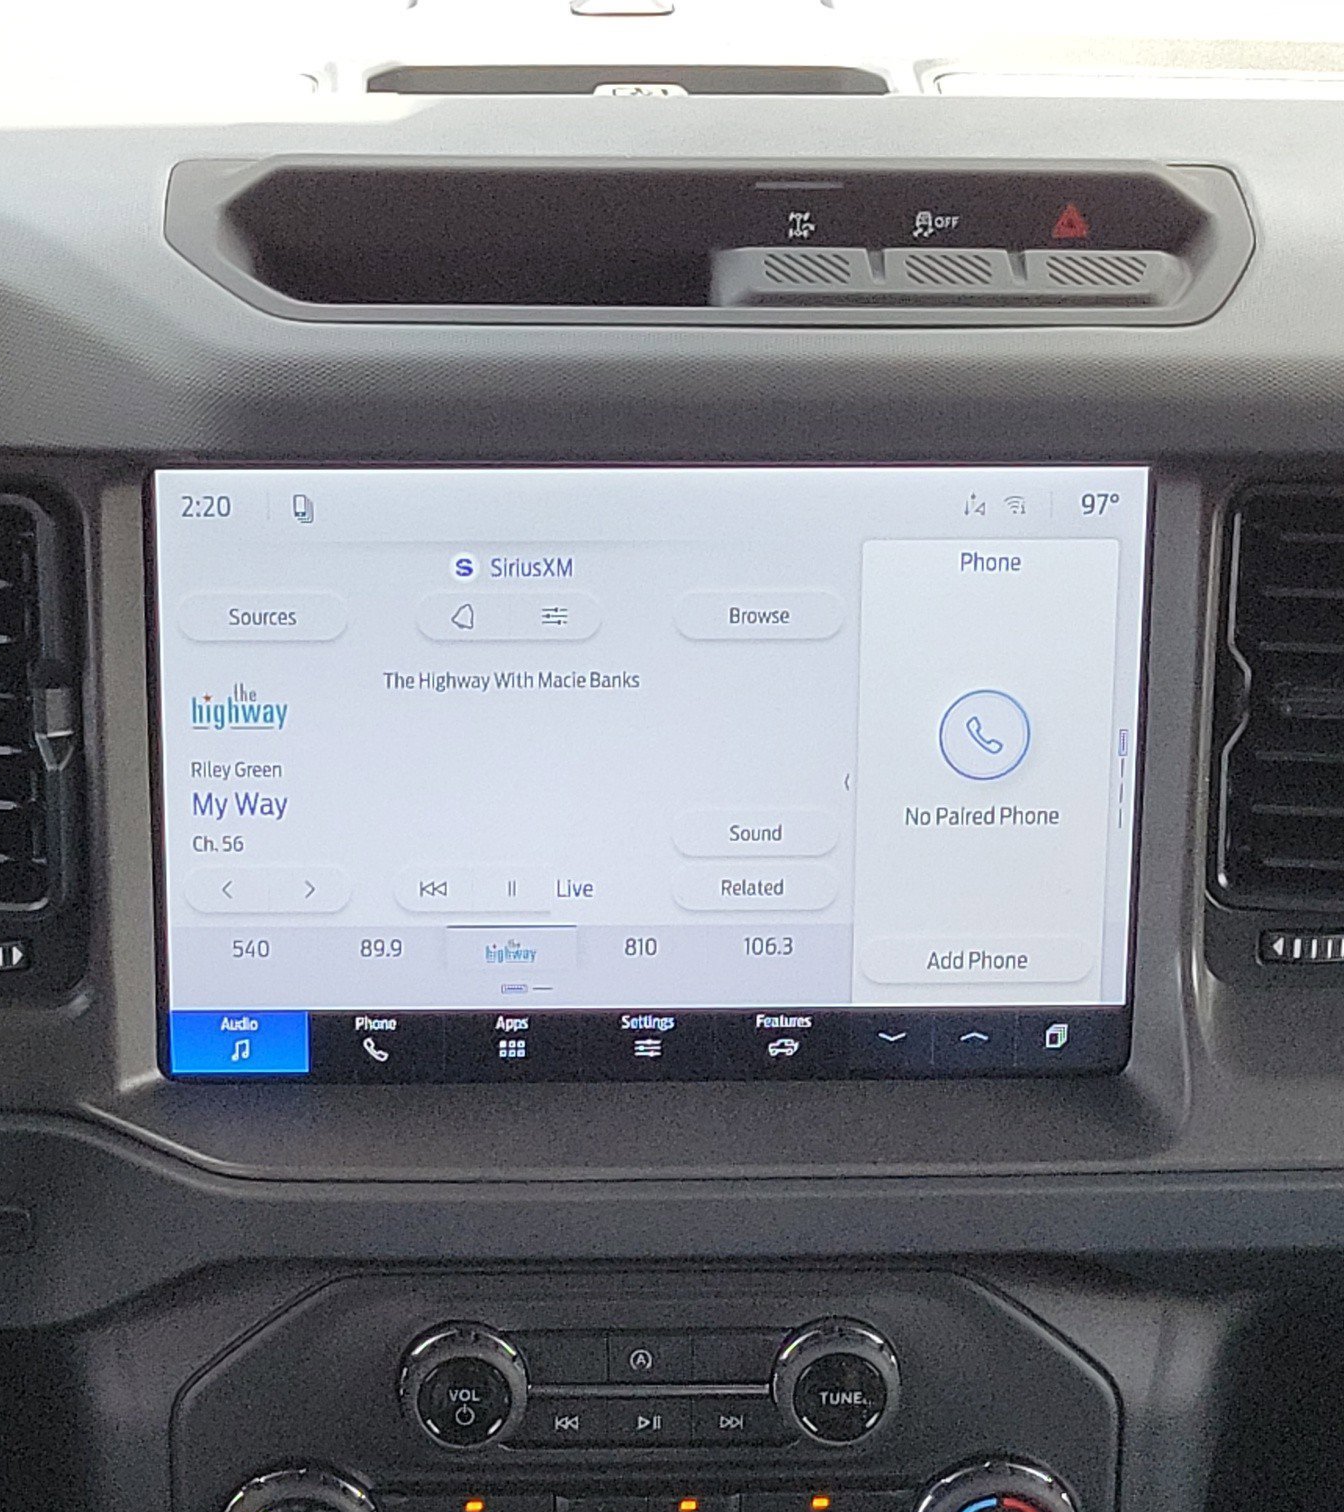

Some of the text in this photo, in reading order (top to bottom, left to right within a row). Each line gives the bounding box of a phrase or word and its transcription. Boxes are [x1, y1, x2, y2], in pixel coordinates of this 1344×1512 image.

[934, 215, 959, 229] OFF
[181, 495, 232, 519] 2:20
[490, 557, 574, 578] SiriusXM
[959, 551, 1022, 573] Phone
[229, 607, 297, 627] Sources
[729, 607, 790, 625] Browse
[383, 671, 640, 692] The Highway With Macie Banks
[233, 683, 257, 702] the
[191, 695, 288, 730] highway
[191, 761, 282, 780] Riley Green
[192, 791, 288, 821] My Way
[905, 807, 1060, 827] No Paired Phone
[729, 824, 782, 842] Sound
[192, 834, 244, 853] Ch. 56
[557, 879, 594, 898] Live
[720, 879, 784, 896] Related
[232, 939, 270, 958] 540
[360, 939, 403, 958] 89.9
[624, 938, 657, 957] 810
[744, 937, 794, 956] 106.3
[927, 951, 1029, 970] Add Phone
[220, 1016, 259, 1032] Audio
[355, 1016, 397, 1031] Phone
[495, 1015, 529, 1033] Apps
[621, 1014, 675, 1032] Settings
[756, 1014, 812, 1029] Features
[448, 1388, 480, 1402] VOL
[820, 1392, 862, 1406] TUNE
